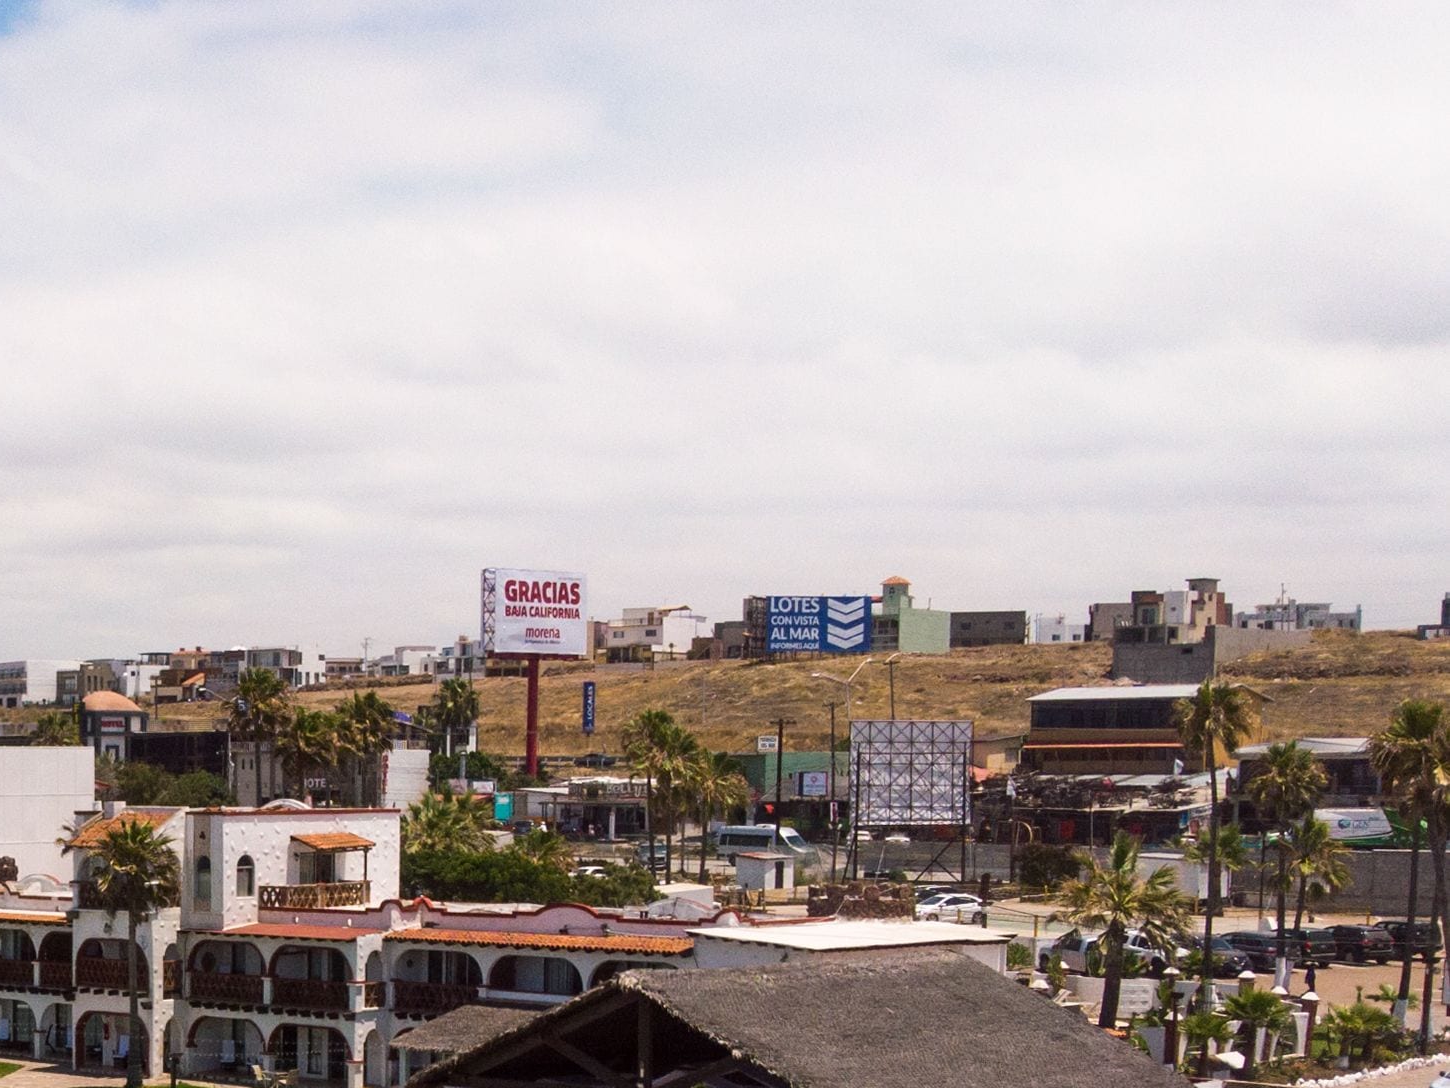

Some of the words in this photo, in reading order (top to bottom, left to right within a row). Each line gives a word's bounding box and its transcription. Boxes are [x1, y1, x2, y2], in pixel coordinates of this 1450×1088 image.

[504, 579, 581, 605] GRACIAS
[770, 597, 820, 613] LOTES
[505, 606, 527, 617] BAJA
[529, 606, 580, 619] CALIFORNIA
[771, 616, 791, 625] CON
[793, 616, 820, 625] VISTA
[525, 628, 560, 639] morena
[771, 627, 787, 640] AL
[789, 627, 819, 640] MAR
